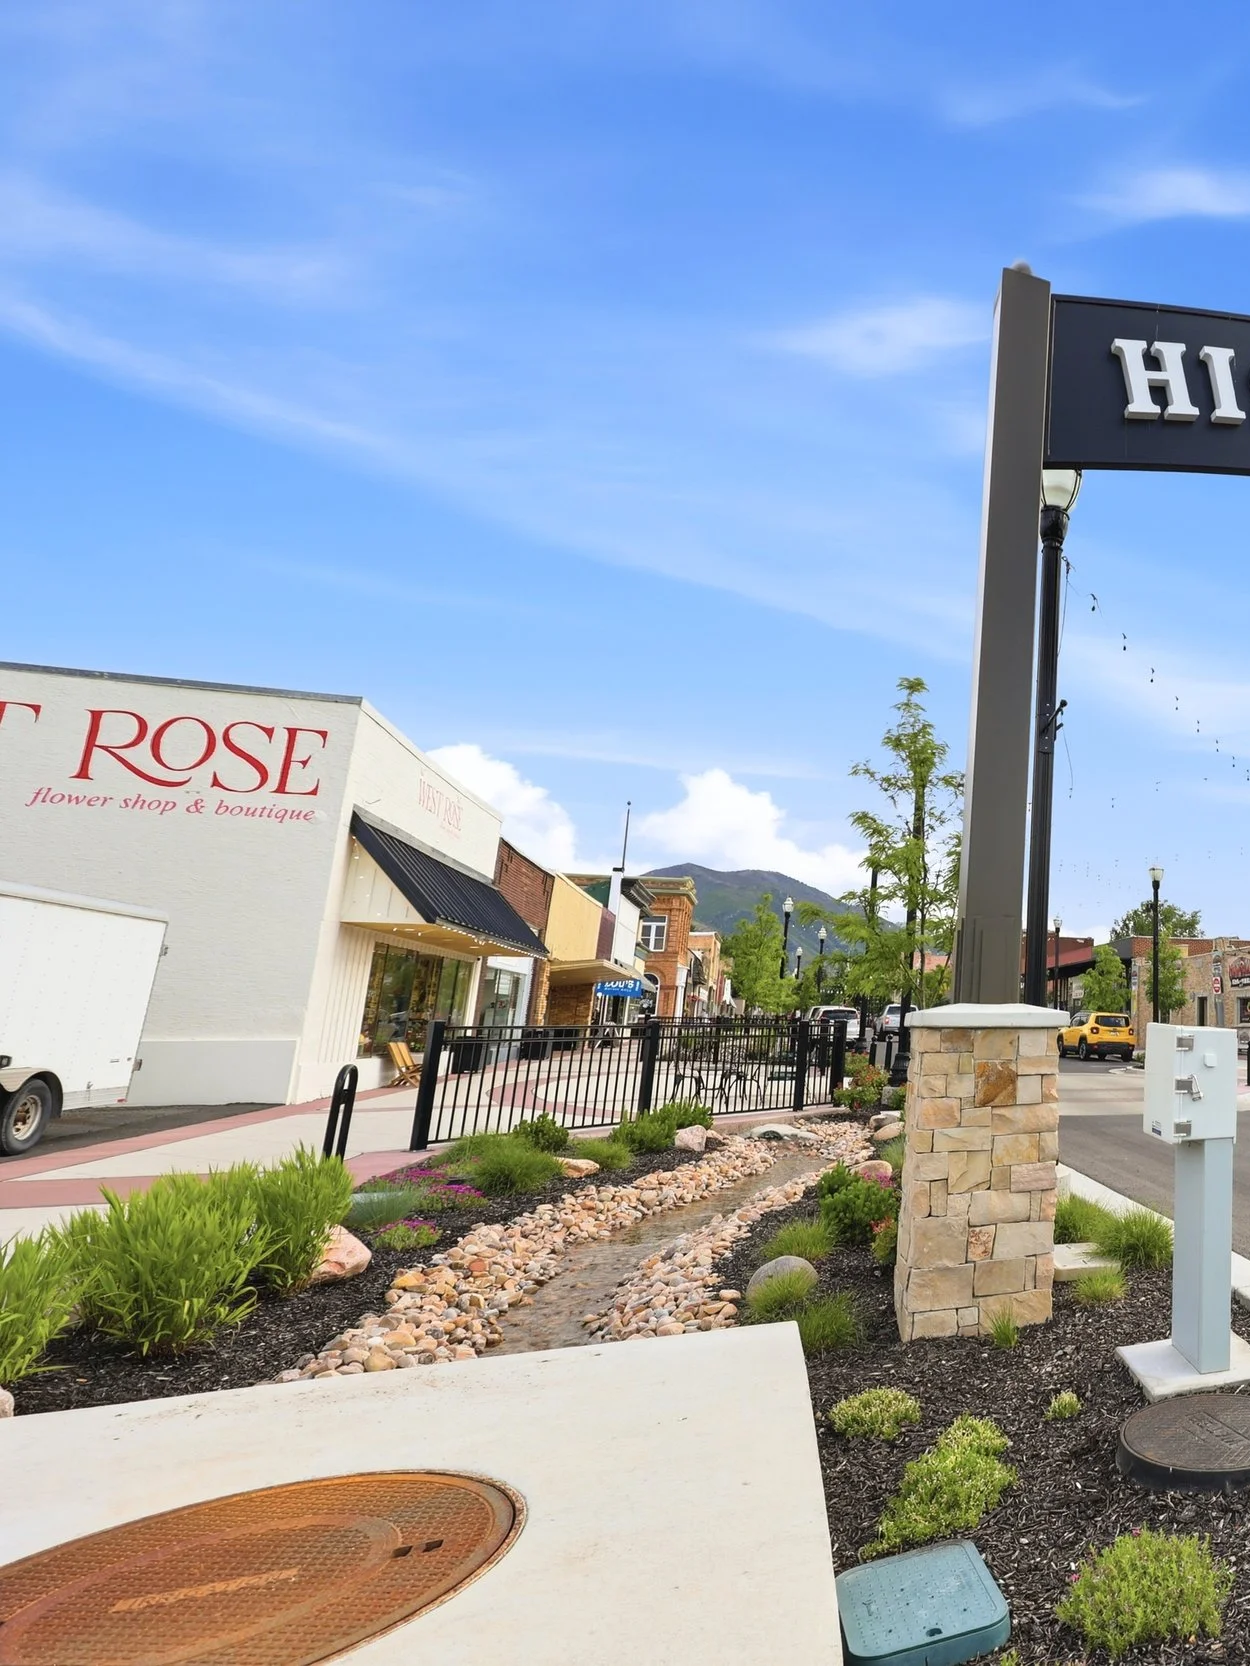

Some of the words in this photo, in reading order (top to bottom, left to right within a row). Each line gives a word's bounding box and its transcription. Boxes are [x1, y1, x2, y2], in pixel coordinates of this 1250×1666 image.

[68, 708, 329, 796] ROSE
[25, 787, 114, 807] flower
[119, 793, 176, 814] shop
[185, 798, 205, 814] &
[214, 800, 316, 824] boutique
